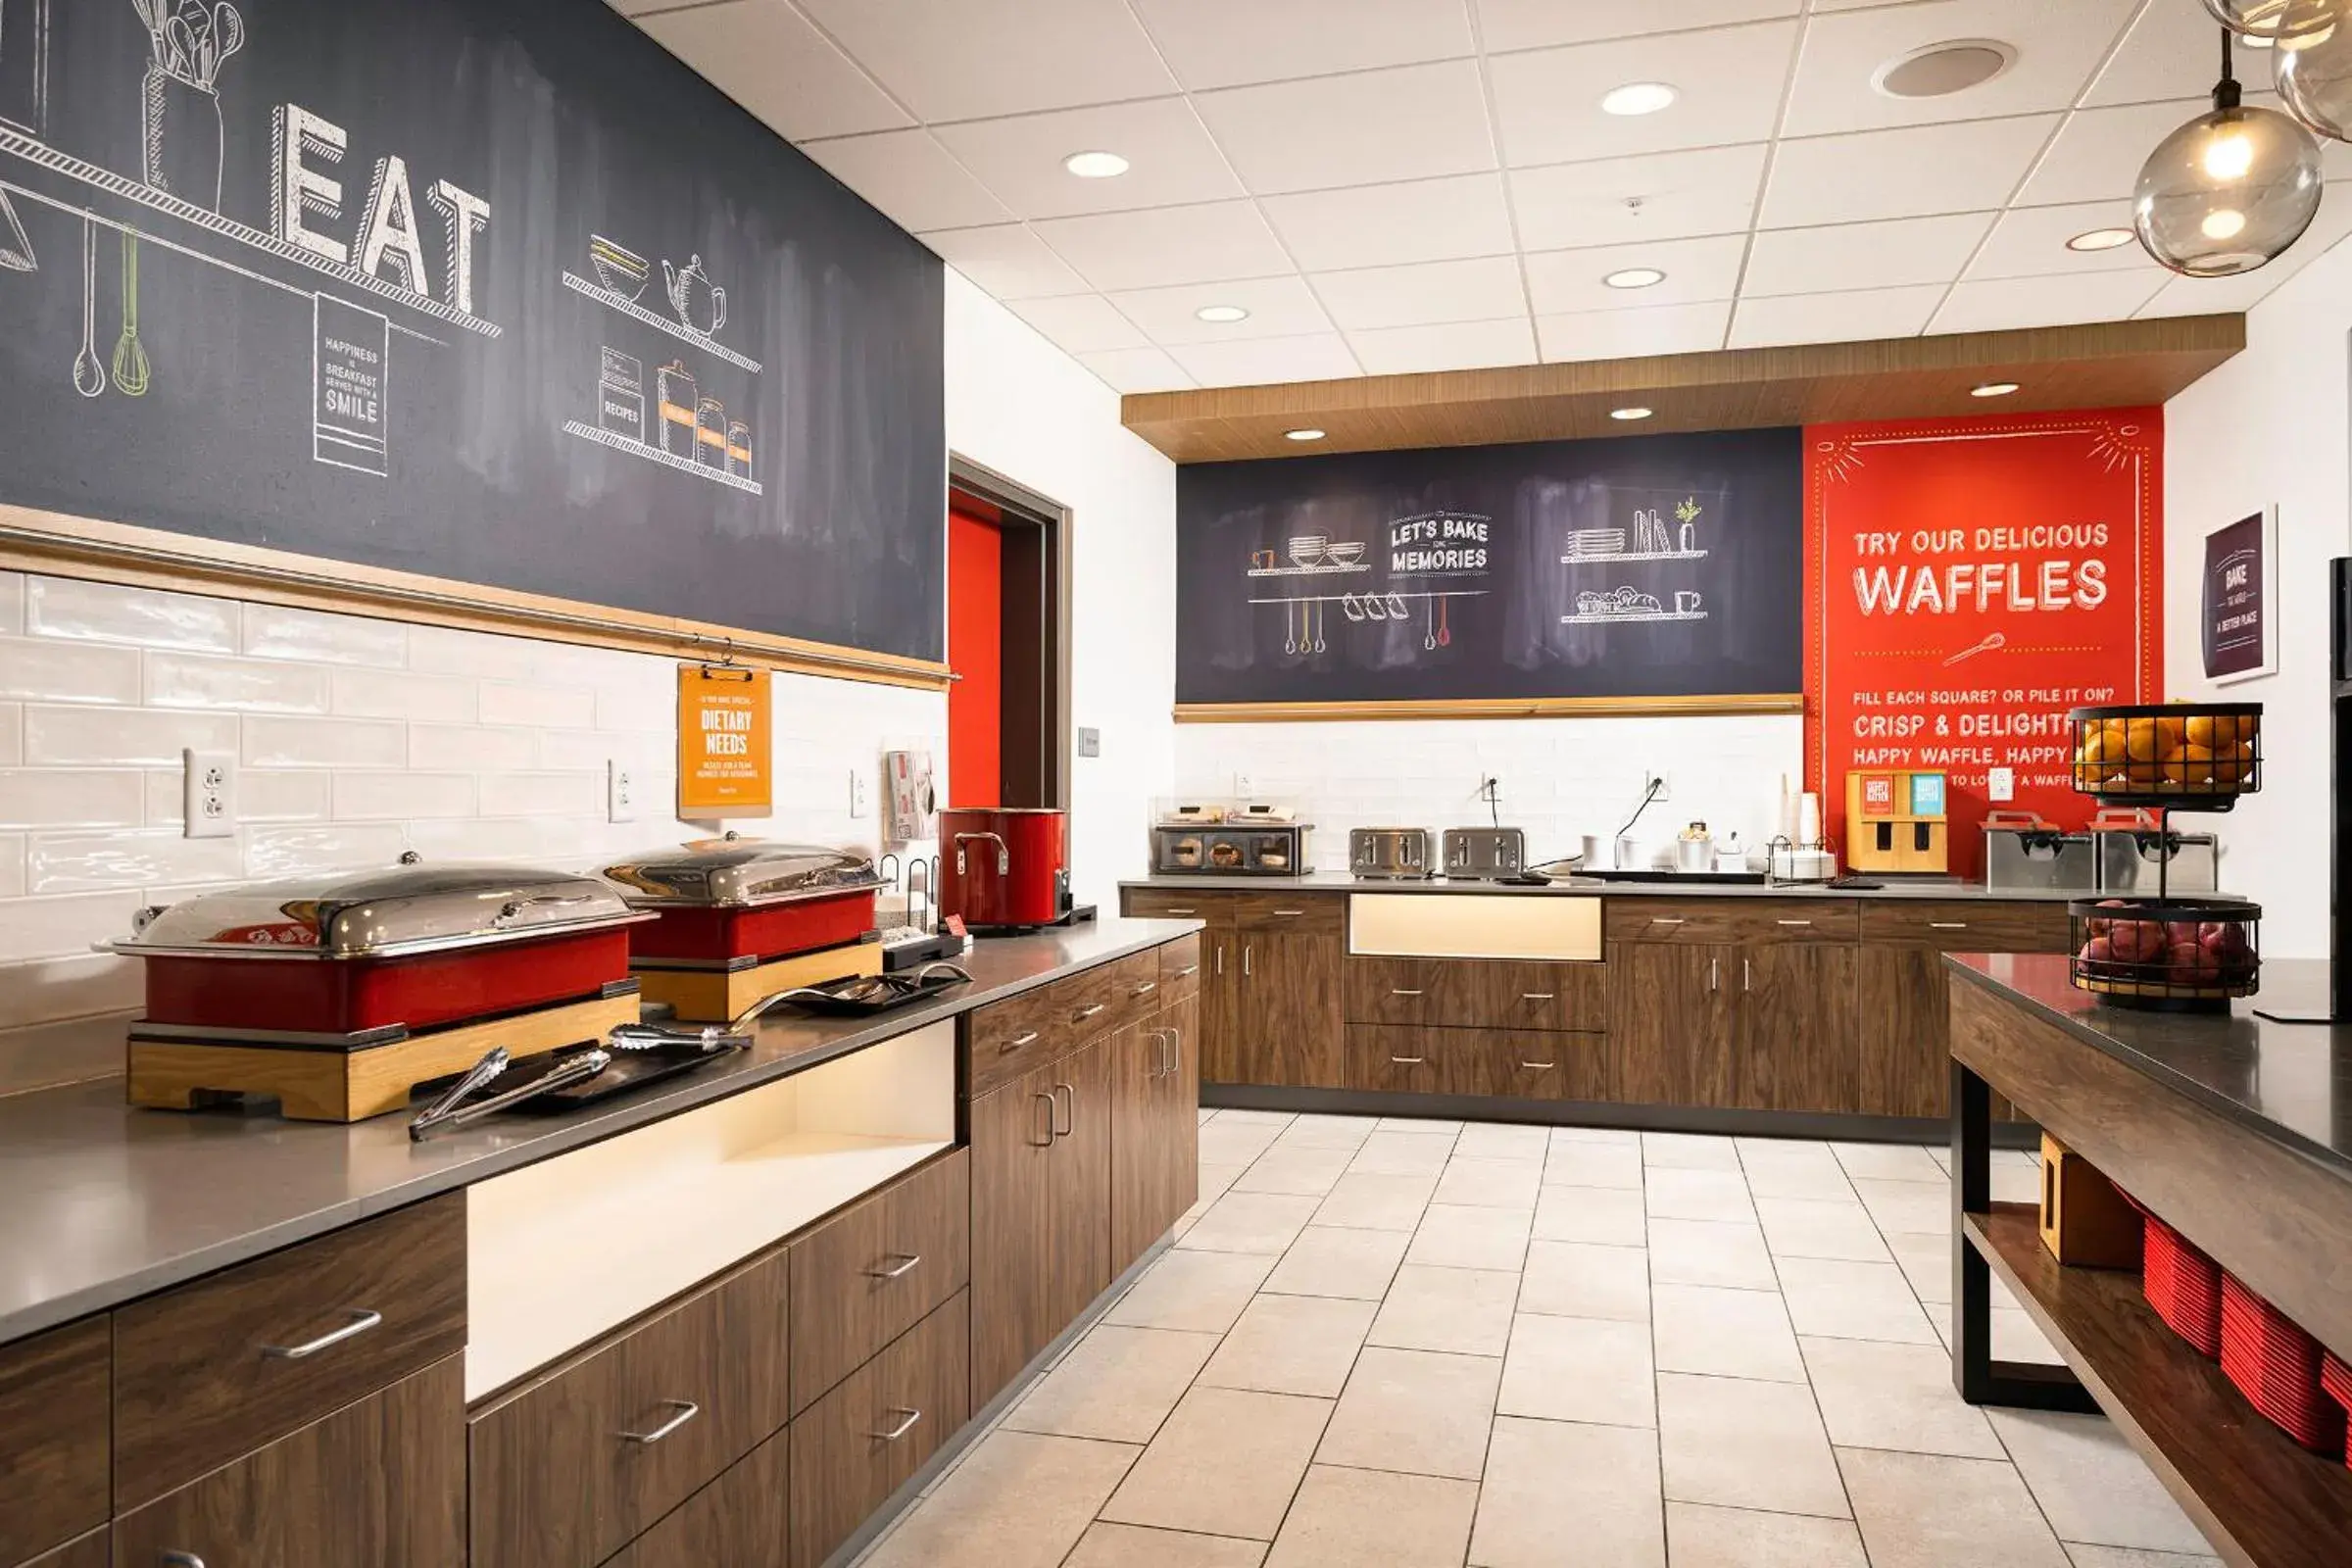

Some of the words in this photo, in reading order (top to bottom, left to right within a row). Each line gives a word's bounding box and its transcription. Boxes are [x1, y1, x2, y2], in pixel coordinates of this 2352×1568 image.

[272, 103, 490, 314] EAT
[325, 336, 377, 364] HAPPINESS
[325, 363, 377, 388] BREAKFAST
[325, 388, 377, 423] SMILE
[605, 400, 639, 423] RECIPES
[1392, 519, 1438, 548] LET'S
[1444, 519, 1489, 542] BAKE
[1853, 531, 1901, 557] TRY
[1911, 528, 1965, 554] OUR
[1975, 522, 2109, 551] DELICIOUS
[1392, 549, 1488, 571] MEMORIES
[1852, 559, 2108, 616] WAFFLES
[2226, 564, 2247, 591] BAKE
[1853, 691, 1882, 706] FILL
[1886, 690, 1926, 705] EACH
[1931, 689, 1997, 705] SQUARE?
[2003, 689, 2024, 703] OR
[2030, 689, 2061, 704] PILE
[2065, 688, 2079, 703] IT
[2084, 688, 2115, 703] ON?
[702, 710, 753, 731] DIETARY
[1854, 714, 1925, 737] CRISP
[1936, 713, 1949, 737] &
[1959, 712, 2074, 737] DELIGHTF
[707, 733, 748, 755] NEEDS
[1853, 748, 1912, 764] HAPPY
[1921, 747, 2000, 765] WAFFLE,
[2006, 746, 2068, 763] HAPPY
[1951, 774, 1968, 786] TO
[2021, 774, 2030, 786] A
[2034, 774, 2075, 787] WAFFL
